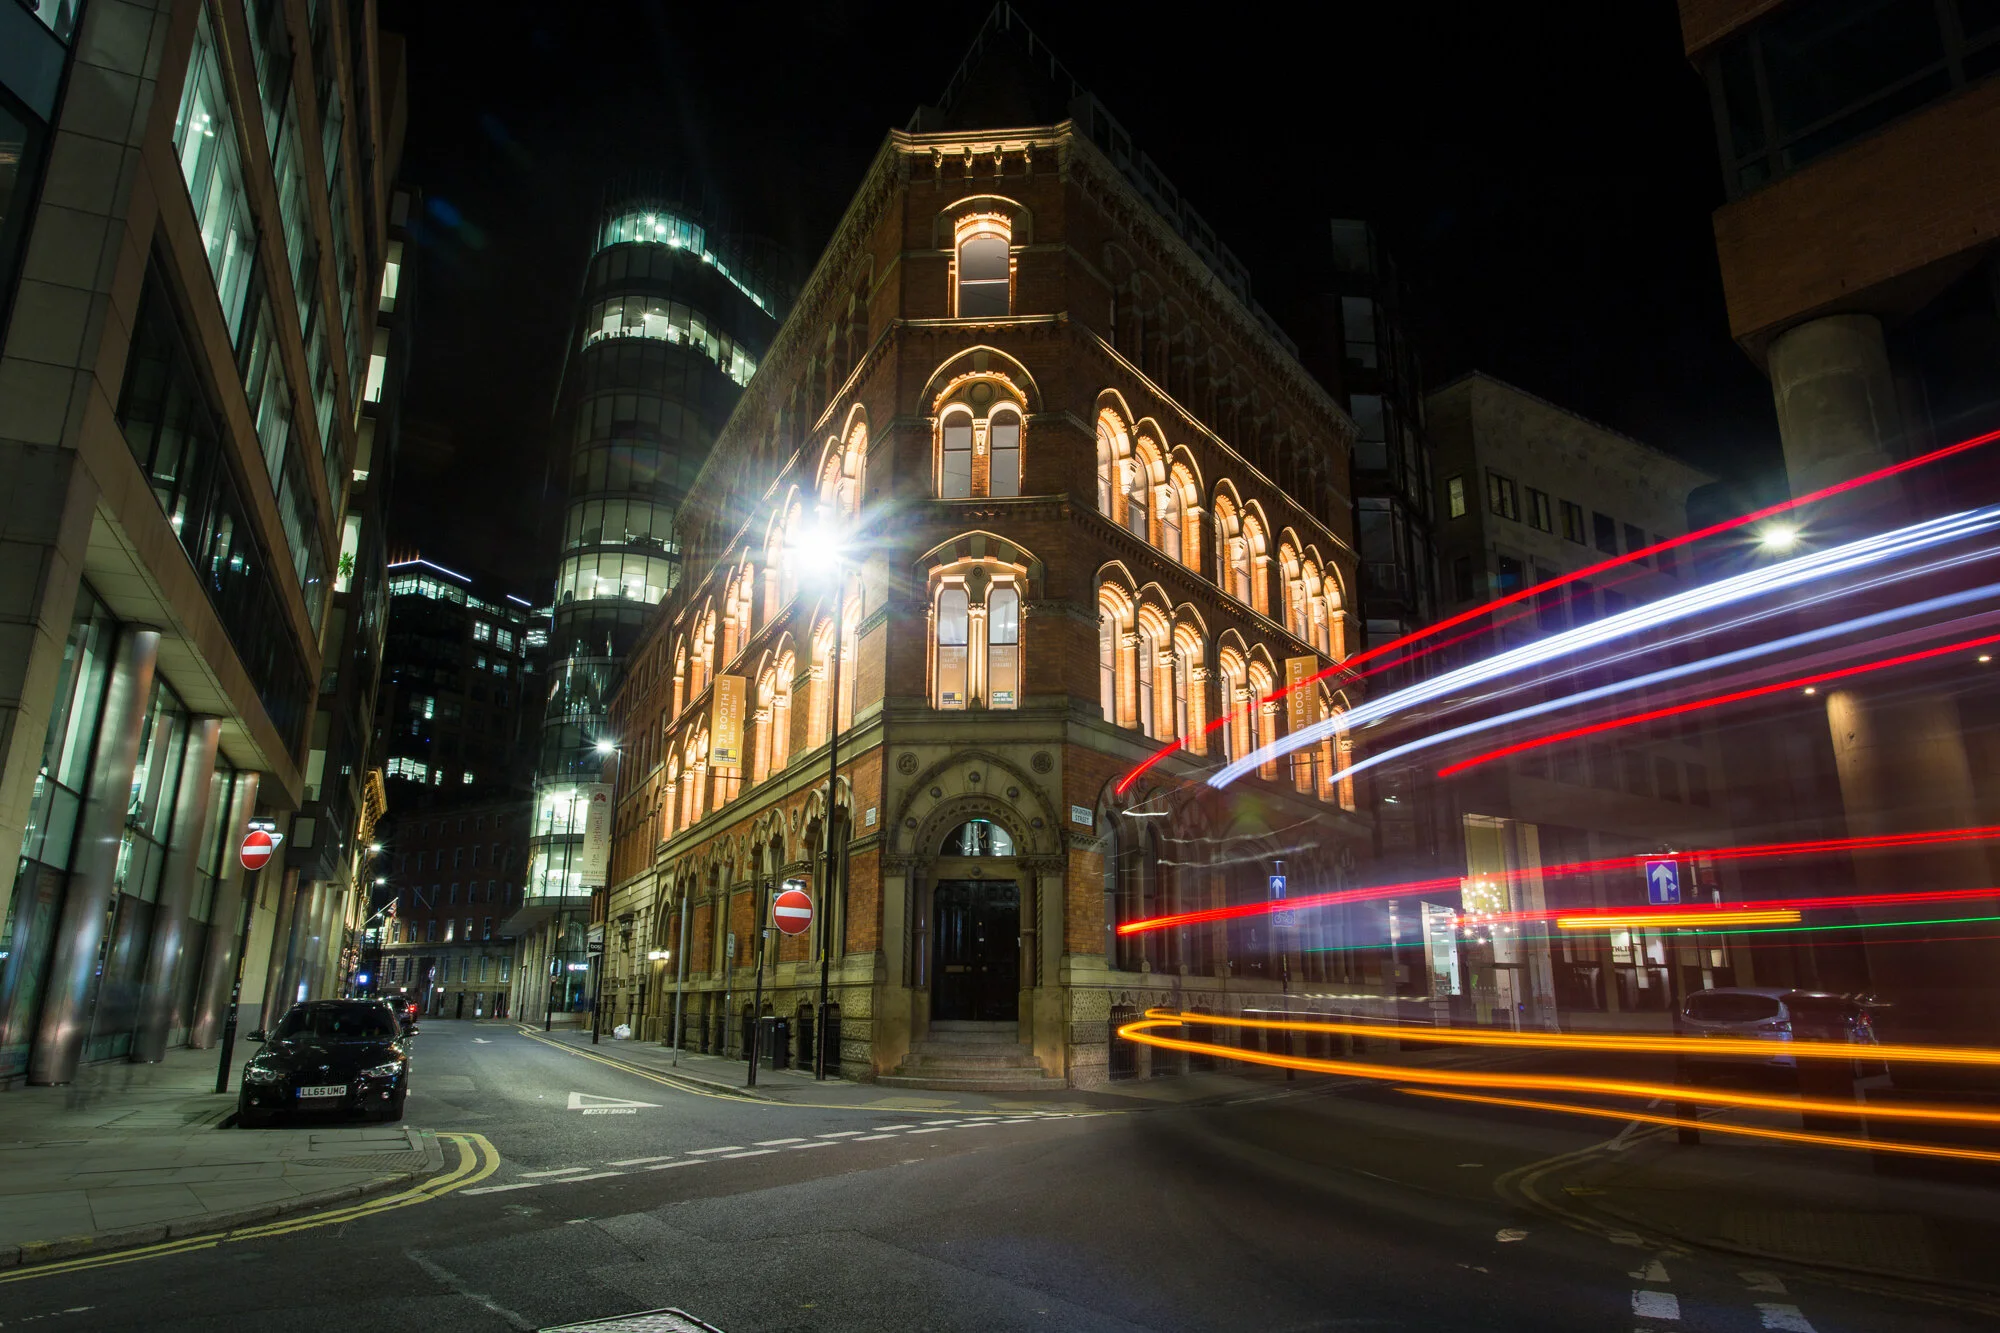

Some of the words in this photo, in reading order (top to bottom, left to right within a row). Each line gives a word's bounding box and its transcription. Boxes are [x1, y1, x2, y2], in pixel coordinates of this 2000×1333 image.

[719, 693, 729, 730] BOOTH
[1295, 676, 1304, 715] BOOTH
[302, 1087, 326, 1096] LL65
